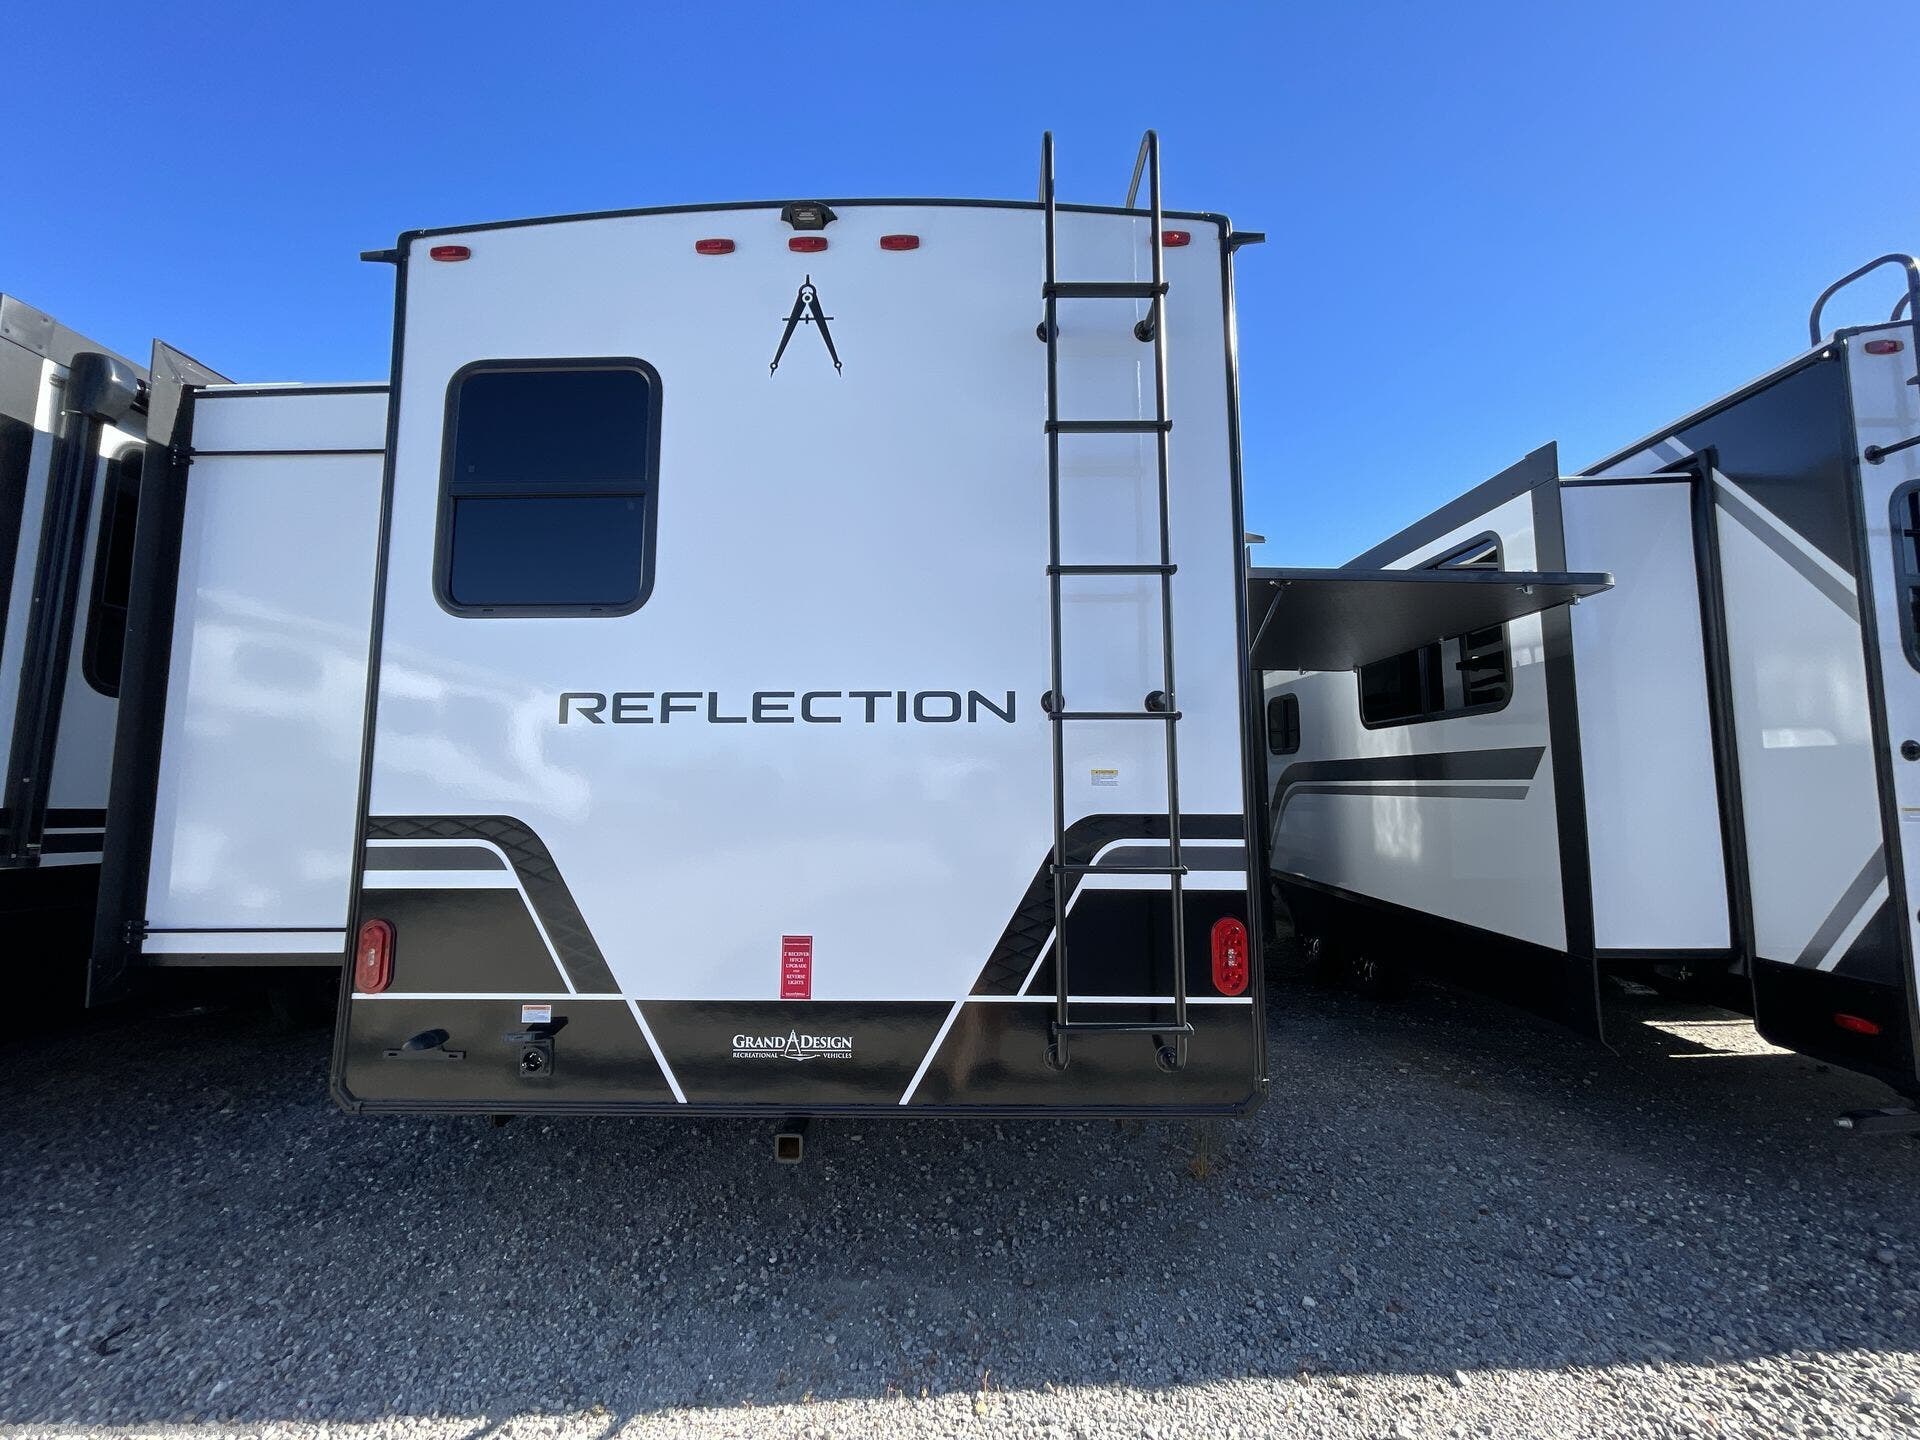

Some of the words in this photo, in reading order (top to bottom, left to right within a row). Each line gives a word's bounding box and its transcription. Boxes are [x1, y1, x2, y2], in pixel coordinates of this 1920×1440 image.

[559, 691, 1016, 724] REFLECTION
[732, 1034, 786, 1048] GRAND
[800, 1035, 853, 1049] DESIGN
